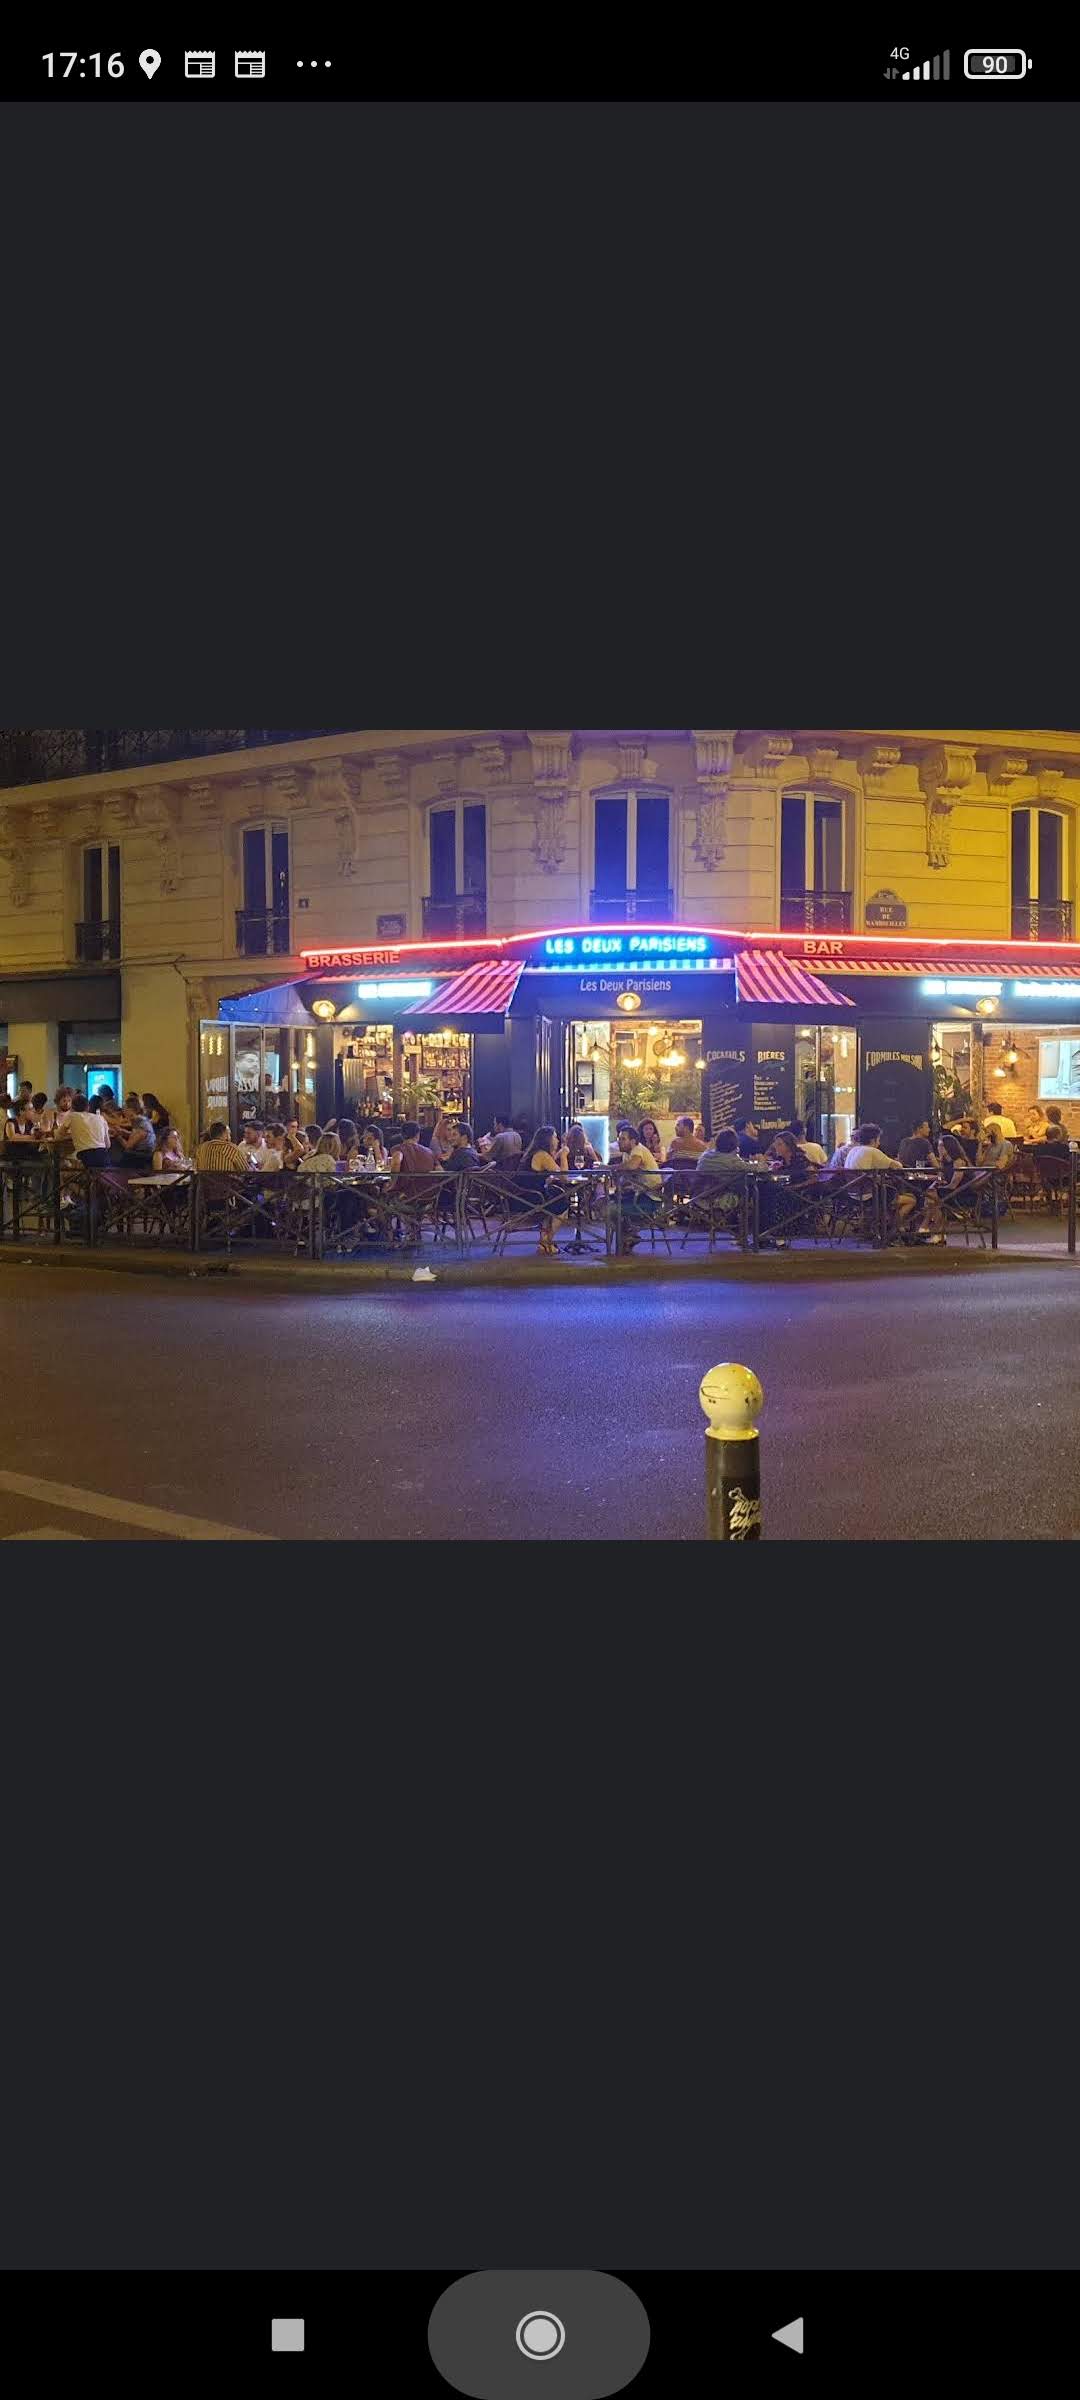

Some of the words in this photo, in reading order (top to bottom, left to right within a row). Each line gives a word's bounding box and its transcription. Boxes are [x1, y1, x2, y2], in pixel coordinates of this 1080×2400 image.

[545, 938, 574, 954] LES
[582, 936, 622, 953] DEUX
[629, 935, 707, 952] PARISIENS
[803, 941, 844, 955] BAR
[308, 951, 400, 968] BRASSERIE
[580, 979, 597, 991] Les
[600, 979, 624, 991] Deux
[626, 978, 671, 991] Parisiens
[865, 1051, 900, 1072] FORMULES
